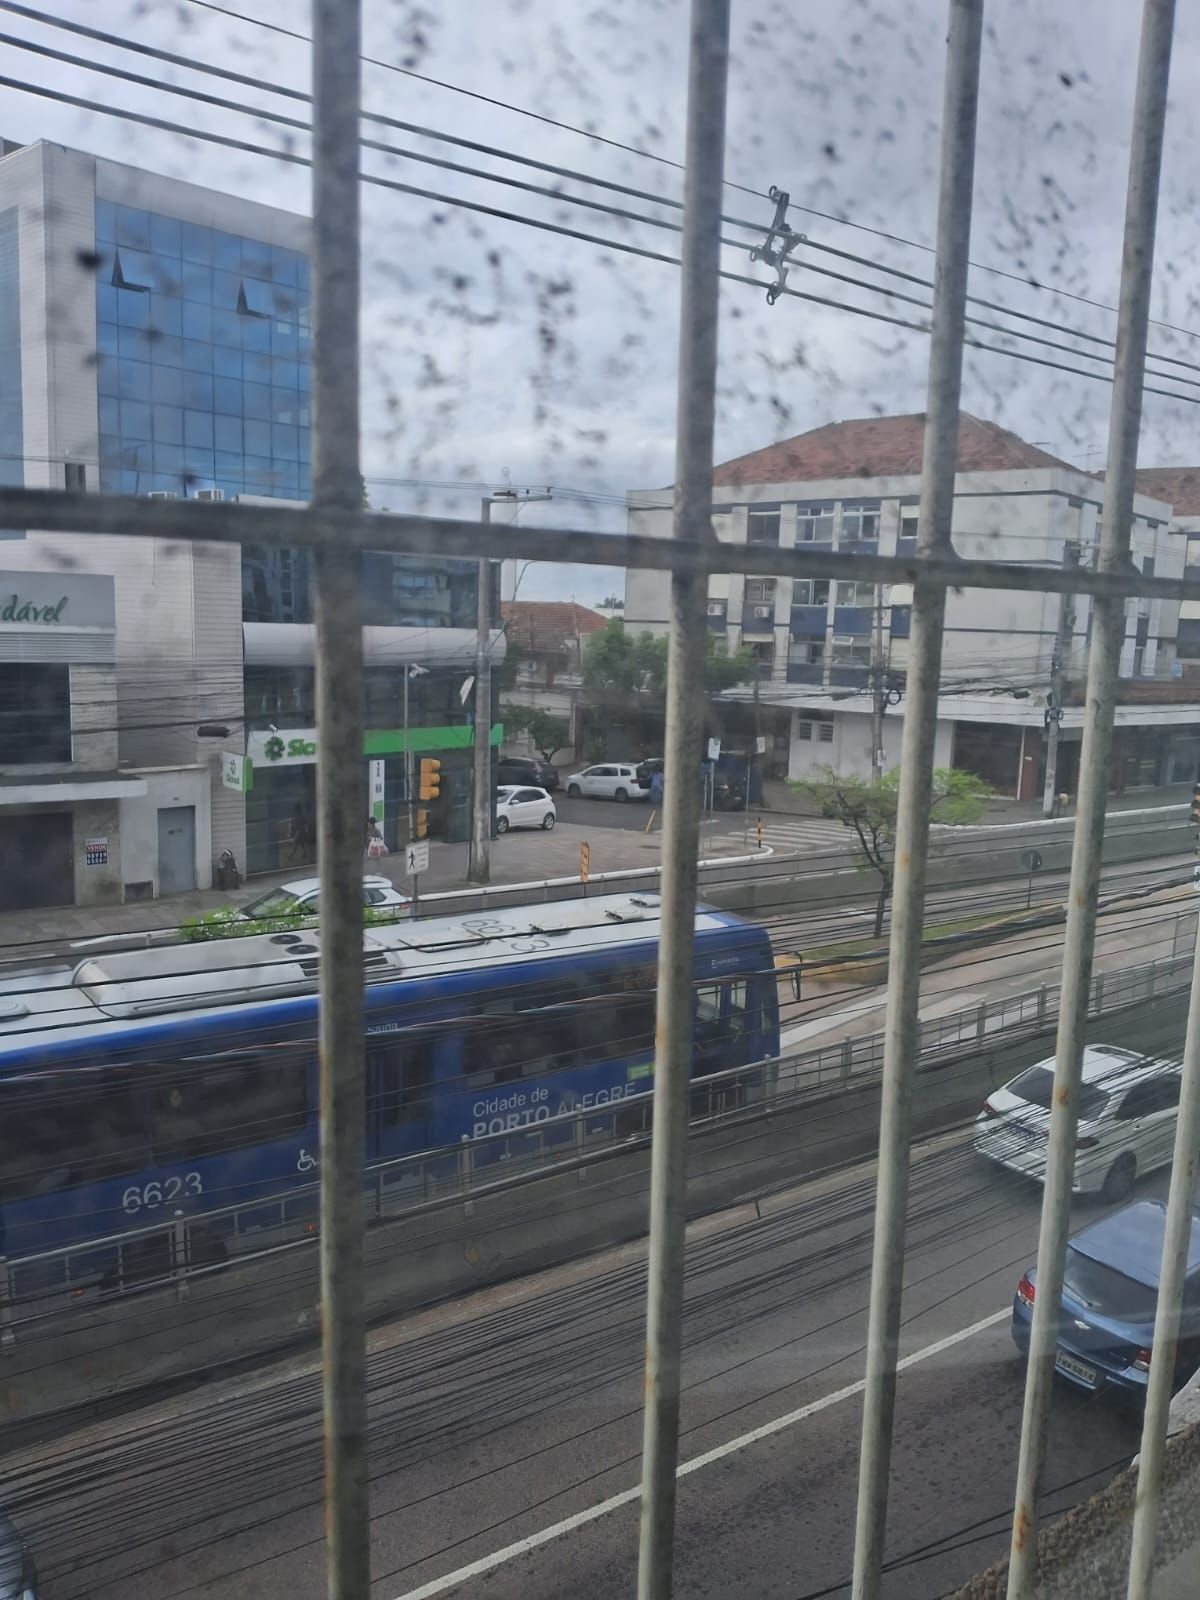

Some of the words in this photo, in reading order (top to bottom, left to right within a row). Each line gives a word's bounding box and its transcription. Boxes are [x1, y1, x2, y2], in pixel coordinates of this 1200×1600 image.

[2, 594, 68, 622] dável
[473, 1091, 526, 1118] Cidade
[530, 1087, 549, 1102] de
[473, 1104, 550, 1139] PORTO
[122, 1172, 203, 1214] 6623
